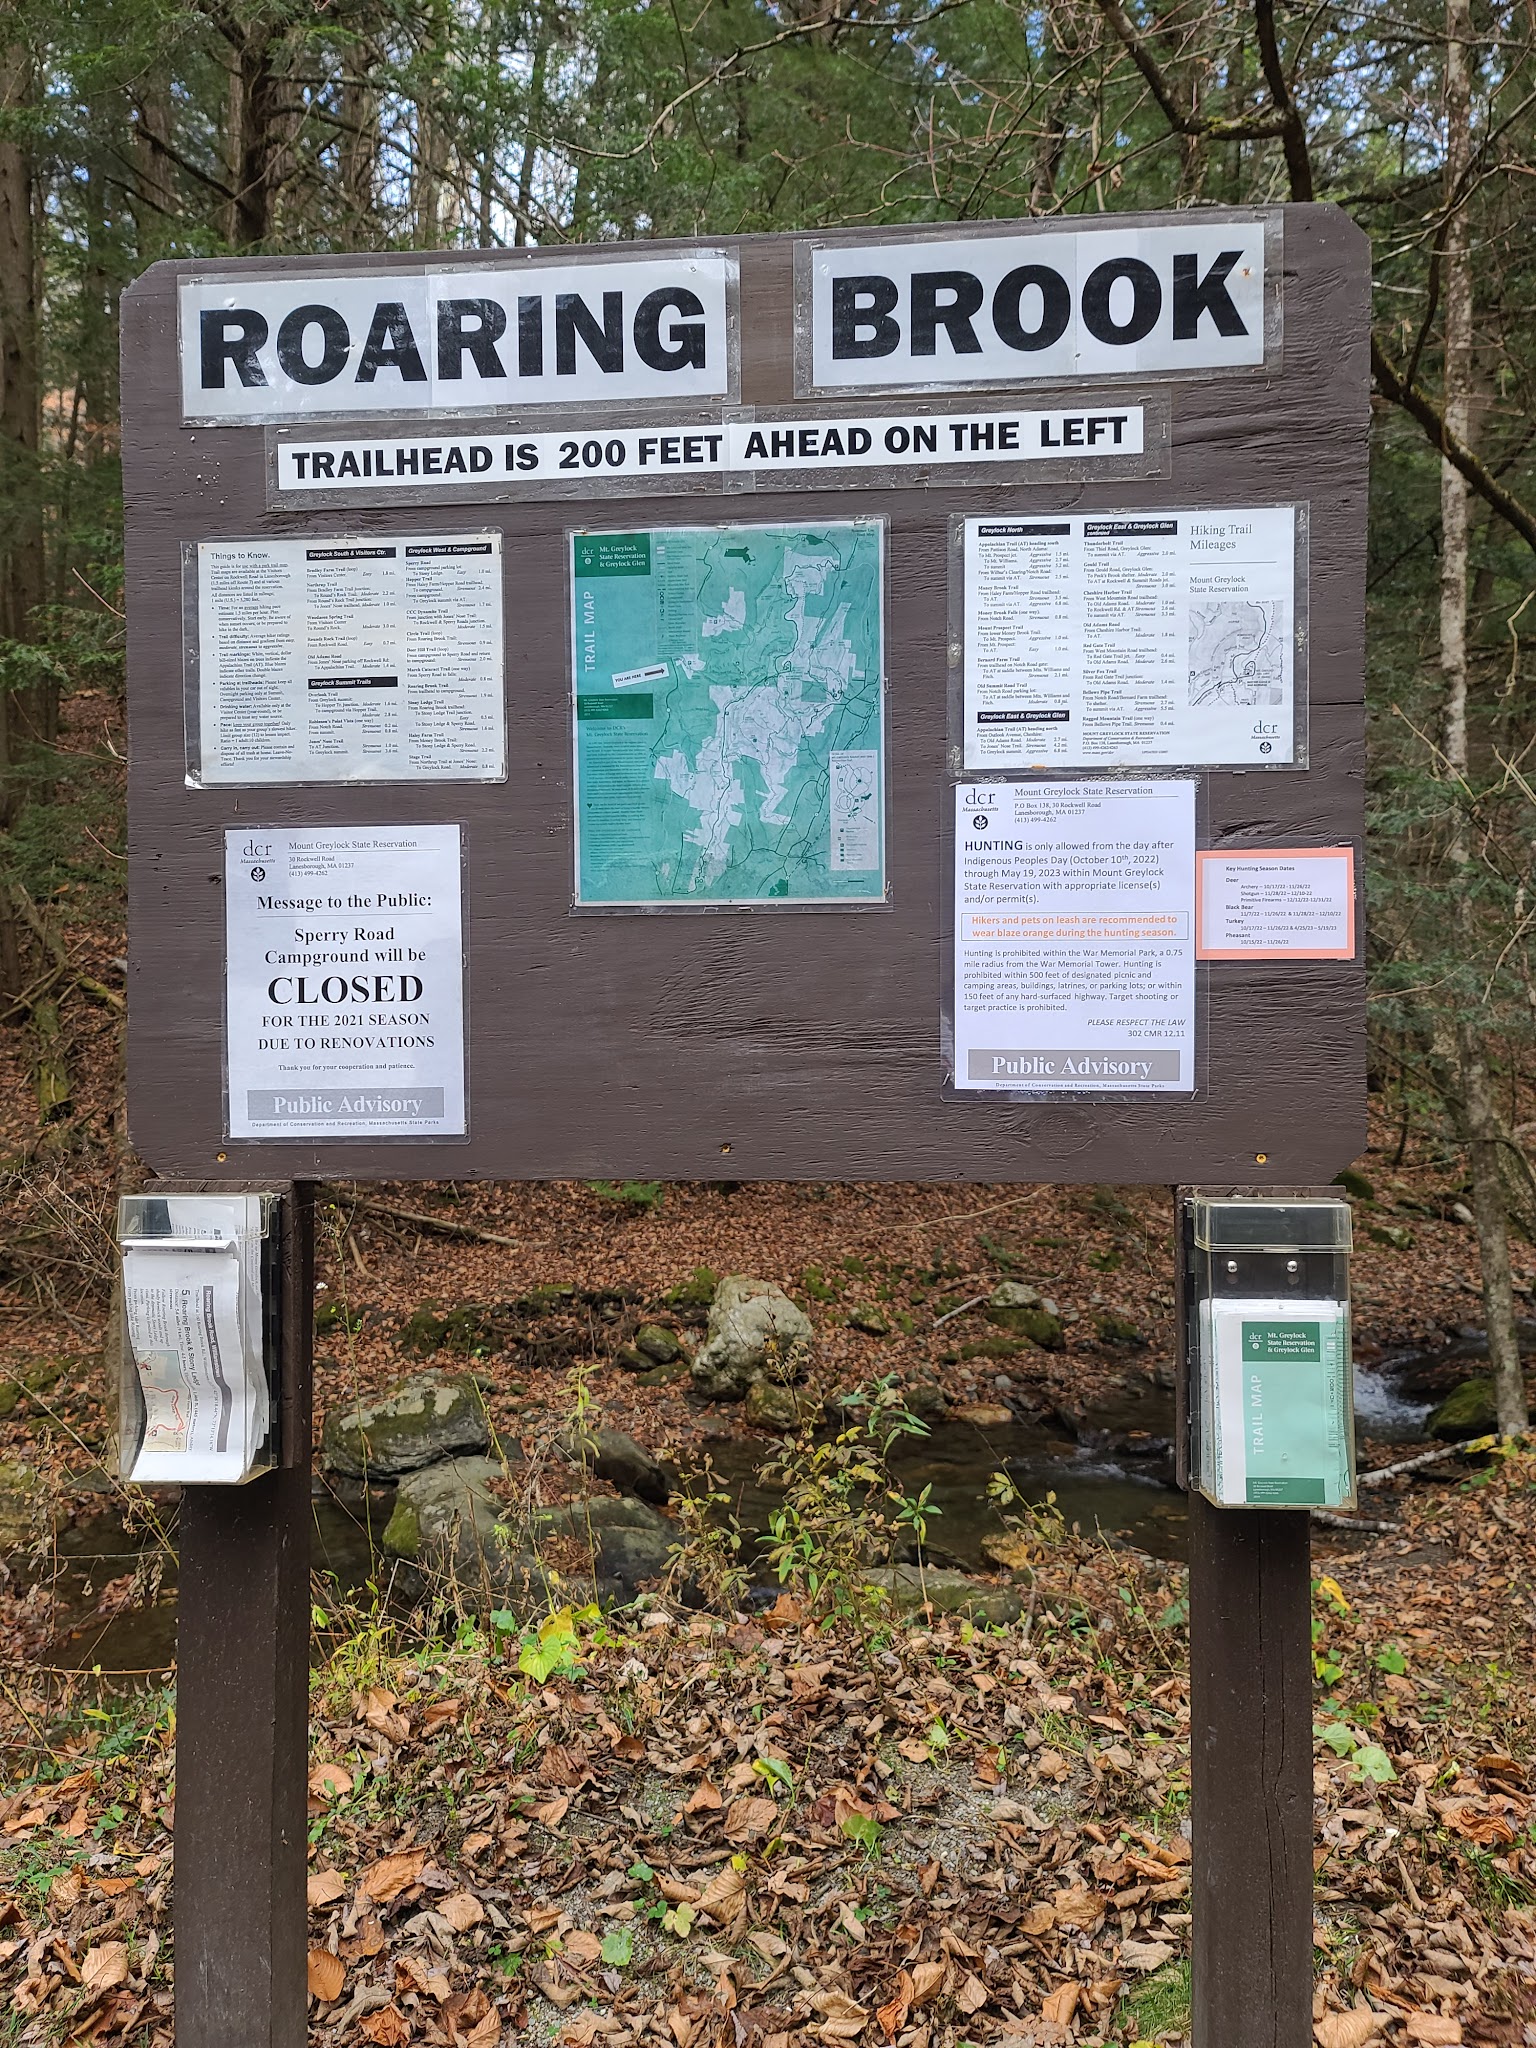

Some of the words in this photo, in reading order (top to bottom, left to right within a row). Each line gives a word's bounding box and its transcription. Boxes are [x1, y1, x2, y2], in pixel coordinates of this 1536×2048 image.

[832, 250, 1249, 359] BROOK
[200, 287, 705, 389] ROARING
[744, 427, 871, 458] AHEAD
[884, 424, 936, 453] ON
[949, 421, 1019, 451] THE
[1041, 415, 1127, 447] LEFT
[292, 446, 492, 478] TRAILHEAD
[505, 443, 538, 471] IS
[559, 439, 625, 468] 200
[639, 435, 722, 465] FEET
[1190, 525, 1225, 536] Hiking
[1228, 524, 1251, 534] Trail
[580, 547, 594, 556] dcr
[611, 544, 637, 554] Greylock
[1190, 539, 1236, 550] Mileages
[605, 560, 630, 568] Greylock
[1214, 575, 1245, 584] Greylock
[584, 592, 595, 624] MAP
[585, 631, 596, 672] TRAIL
[1253, 720, 1277, 733] dcr
[965, 788, 995, 804] dcr
[1015, 788, 1041, 796] Mount
[1043, 787, 1079, 796] Greylock
[1083, 787, 1102, 795] State
[1105, 786, 1152, 794] Reservation
[243, 840, 271, 856] dcr
[315, 841, 349, 849] Greylock
[965, 840, 1022, 850] HUNTING
[1034, 842, 1052, 851] only
[1116, 841, 1130, 849] the
[1133, 841, 1149, 850] day
[1151, 840, 1173, 848] after
[965, 857, 1011, 866] Indigenous
[1015, 856, 1048, 865] Peoples
[1051, 856, 1067, 865] Day
[1070, 855, 1108, 865] (October
[1133, 855, 1158, 864] 2022)
[964, 869, 998, 879] through
[1002, 869, 1020, 878] May
[1023, 869, 1036, 878] 19,
[1062, 868, 1089, 876] within
[1125, 868, 1163, 877] Greylock
[964, 882, 986, 890] State
[1043, 881, 1062, 889] with
[1065, 881, 1116, 891] appropriate
[1119, 880, 1160, 890] license(s)
[257, 896, 322, 911] Message
[327, 896, 341, 908] to
[348, 894, 371, 907] the
[377, 893, 430, 906] Public:
[964, 894, 994, 904] and/or
[997, 894, 1039, 904] permit(s).
[972, 916, 999, 924] Hikers
[1021, 917, 1040, 925] pets
[1057, 915, 1079, 923] leash
[1099, 915, 1165, 923] recommended
[295, 929, 347, 945] Sperry
[354, 927, 393, 940] Road
[997, 928, 1020, 936] blaze
[1022, 930, 1053, 938] orange
[1056, 928, 1085, 938] during
[1087, 928, 1101, 936] the
[1104, 928, 1139, 938] hunting
[265, 949, 368, 966] Campground
[374, 948, 402, 961] will
[408, 948, 425, 961] be
[268, 975, 422, 1004] CLOSED
[262, 1016, 292, 1027] FOR
[297, 1015, 329, 1026] THE
[334, 1015, 362, 1025] 2021
[369, 1013, 428, 1025] SEASON
[259, 1038, 289, 1049] DUE
[294, 1038, 315, 1049] TO
[321, 1036, 434, 1048] RENOVATIONS
[992, 1057, 1054, 1074] Public
[1060, 1057, 1152, 1079] Advisory
[273, 1096, 333, 1117] Public
[337, 1095, 422, 1115] Advisory
[181, 1300, 189, 1325] Roaring
[185, 1327, 193, 1345] Brook
[1249, 1332, 1261, 1340] dcr
[1267, 1332, 1277, 1340] Mt.
[188, 1353, 196, 1370] Stony
[1251, 1375, 1262, 1406] MAP
[1254, 1413, 1263, 1455] TRAIL
